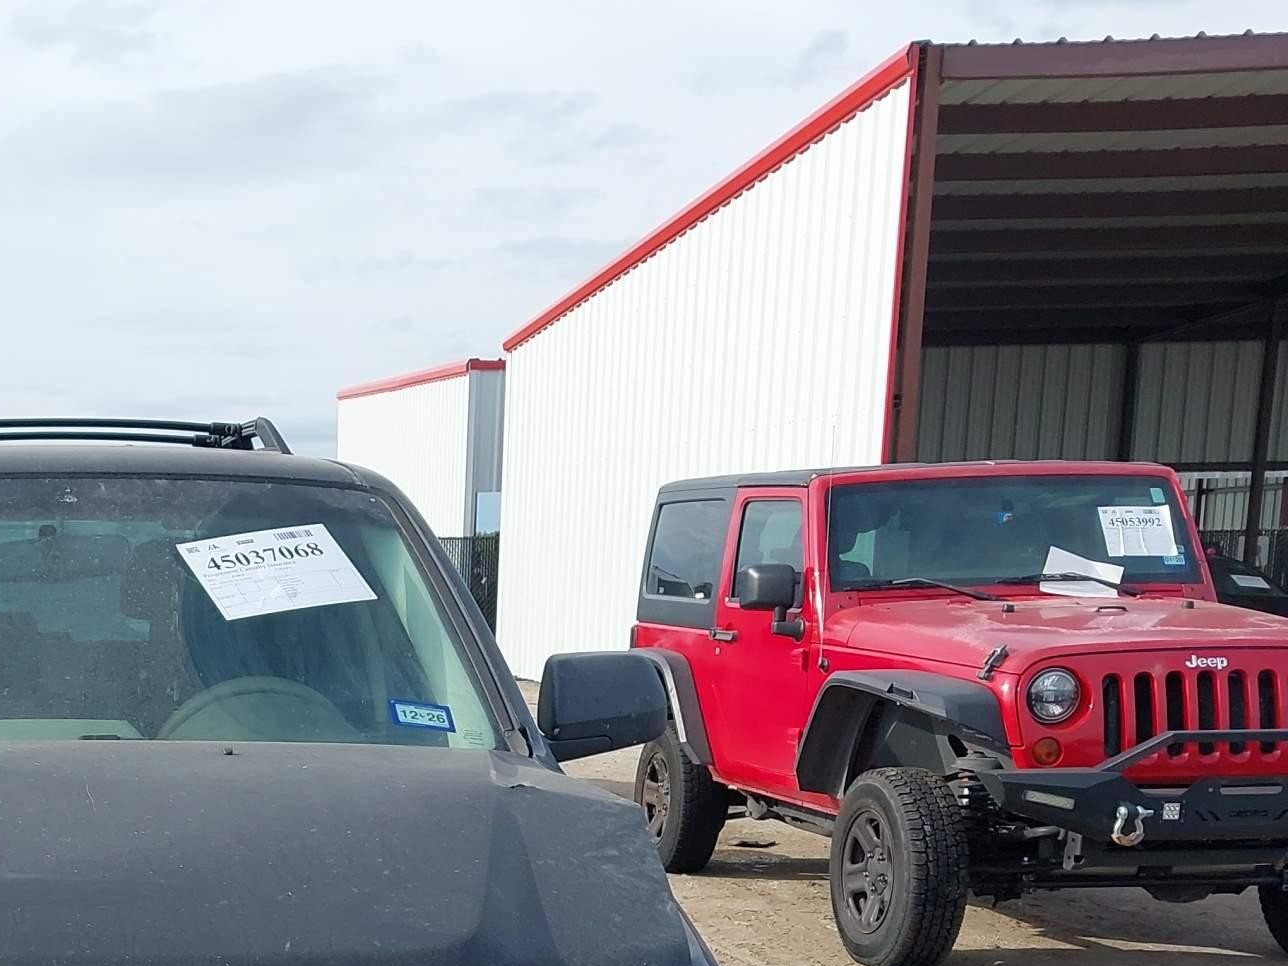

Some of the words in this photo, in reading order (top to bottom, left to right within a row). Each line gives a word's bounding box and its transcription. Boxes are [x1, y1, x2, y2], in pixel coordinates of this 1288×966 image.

[1108, 517, 1163, 527] 45053992
[207, 542, 324, 571] 45037068
[1185, 654, 1228, 670] Jeep
